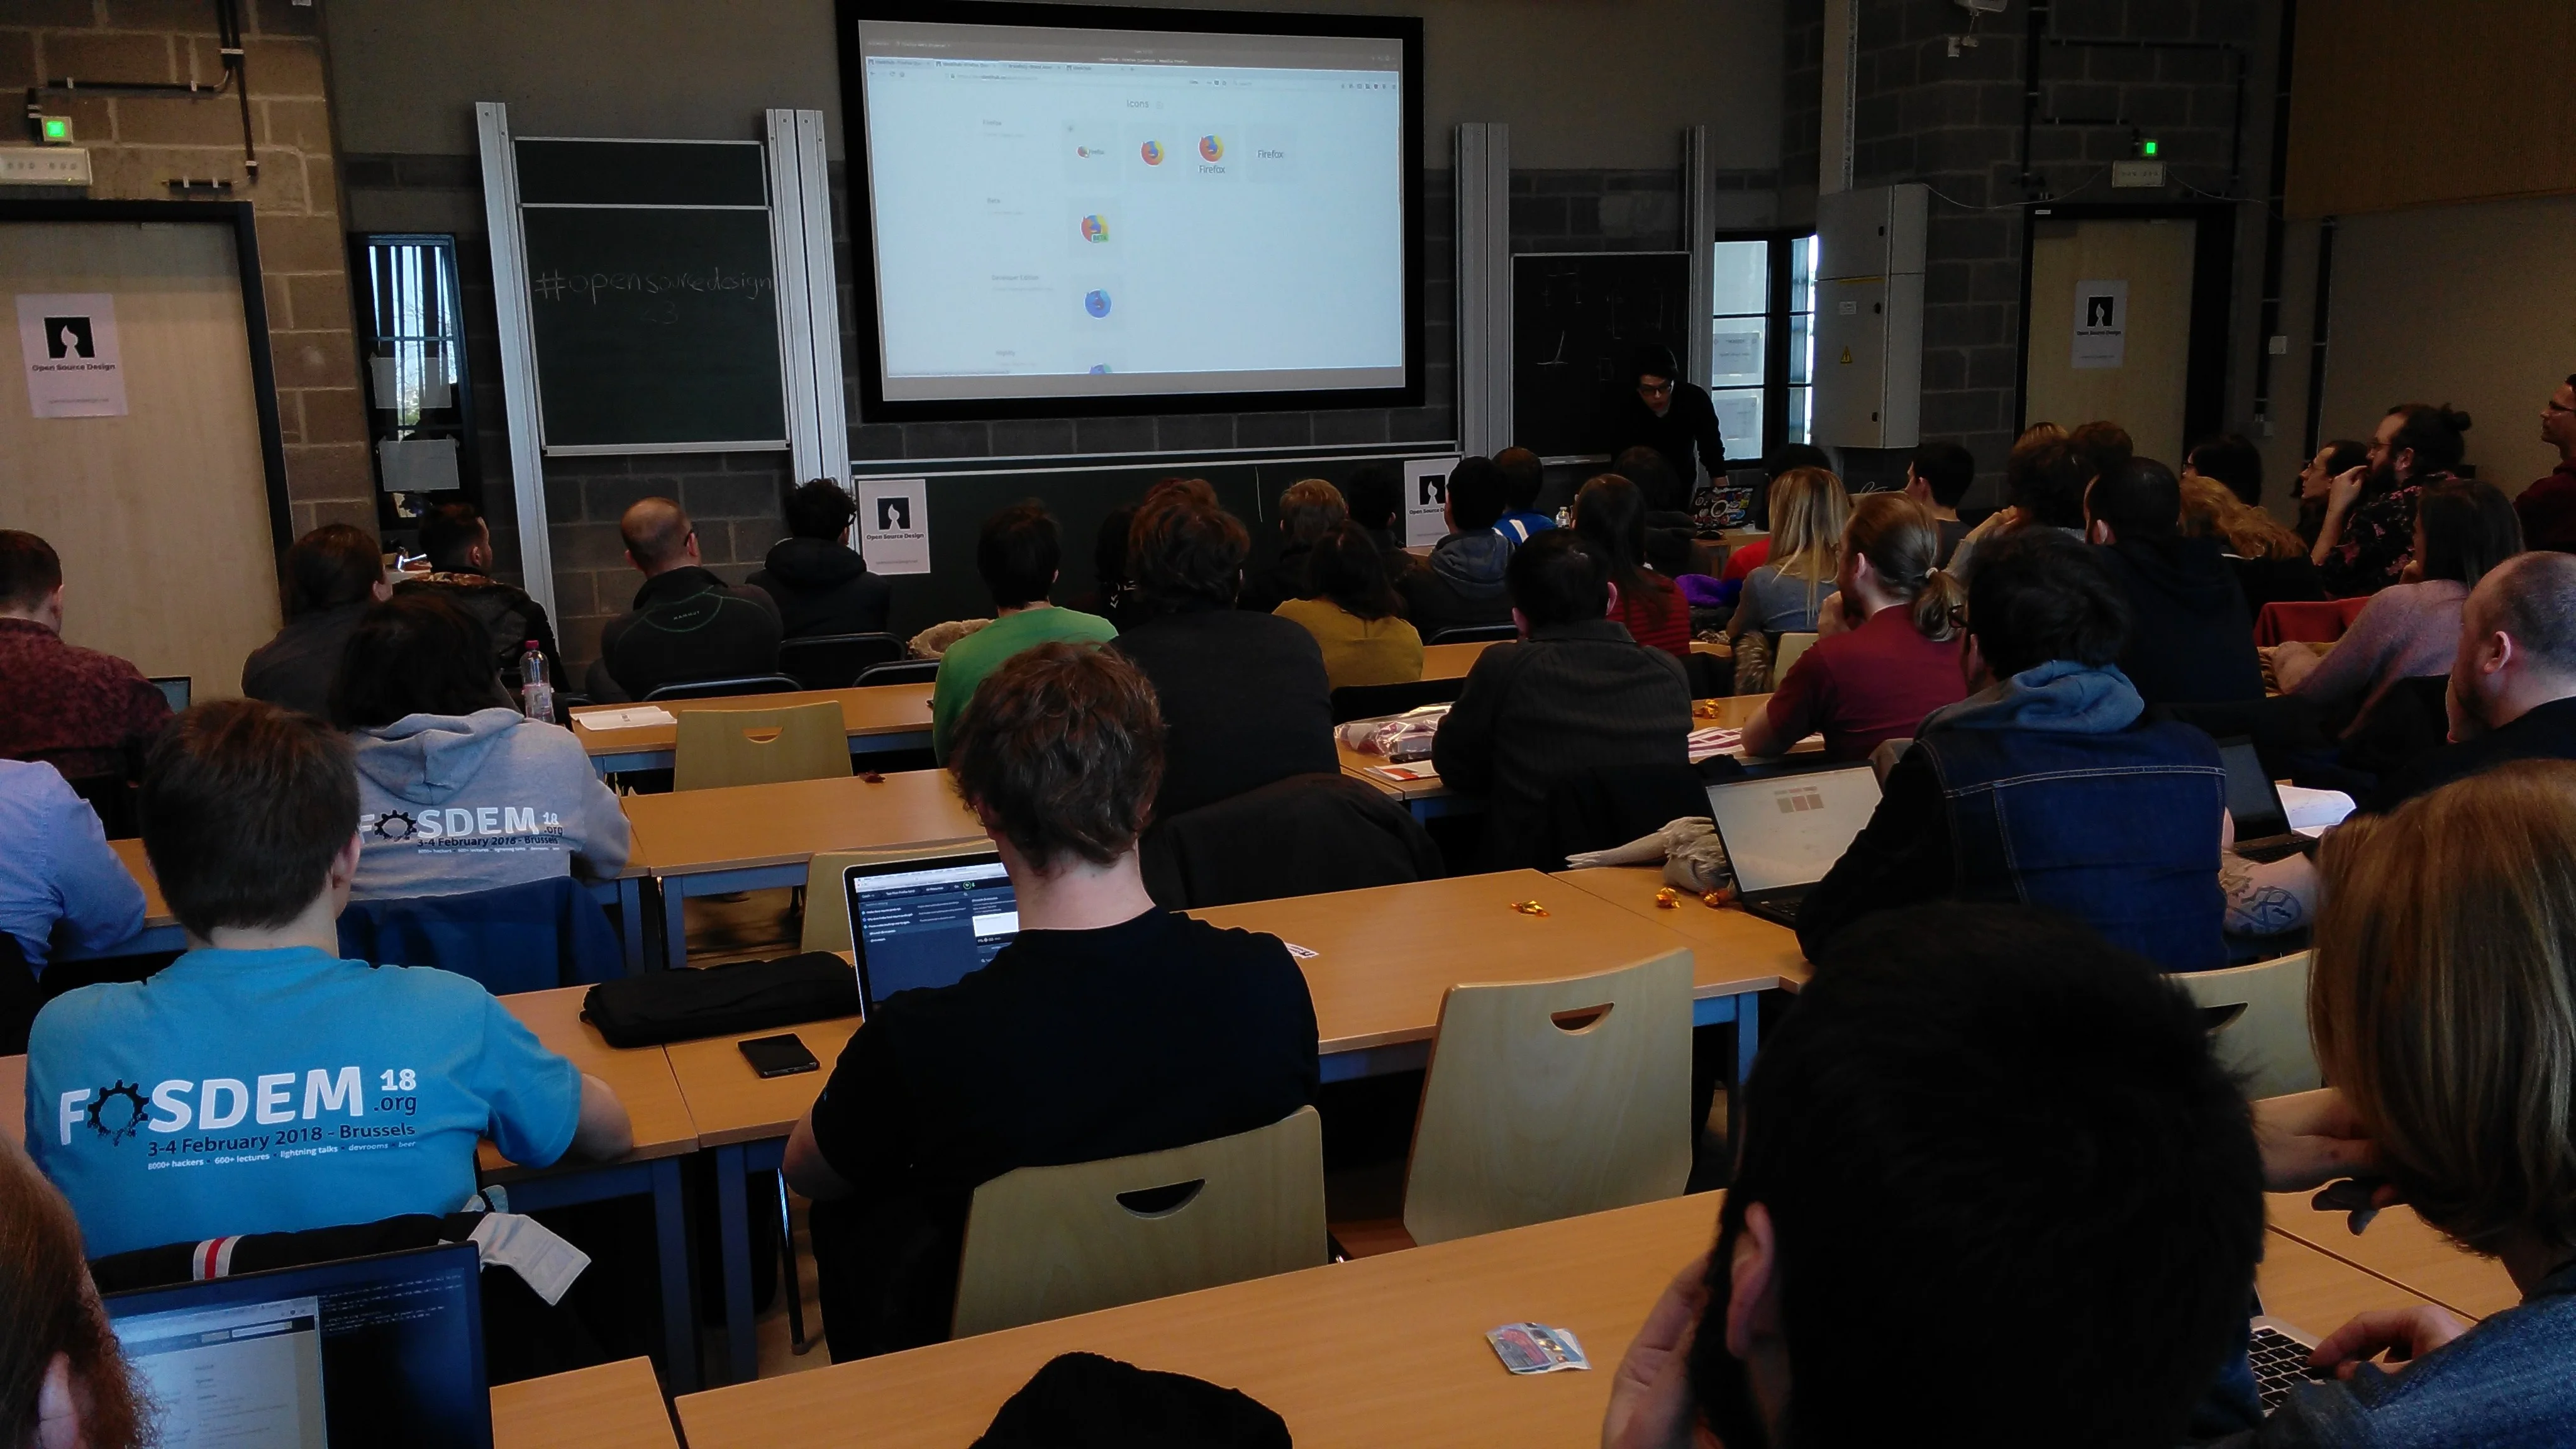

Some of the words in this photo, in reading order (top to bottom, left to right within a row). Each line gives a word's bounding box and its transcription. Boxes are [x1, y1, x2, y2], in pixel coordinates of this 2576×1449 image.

[1258, 150, 1283, 158] Firefox
[1199, 165, 1225, 174] Firefox
[544, 825, 564, 836] .org
[417, 838, 435, 847] 3-4
[438, 837, 489, 847] February
[60, 1066, 364, 1146] FOSDEM
[380, 1069, 416, 1092] 18
[373, 1095, 418, 1116] .org
[148, 1140, 177, 1157] 3-4
[182, 1135, 270, 1153] February
[274, 1126, 323, 1145] 2018
[340, 1121, 416, 1140] Brussels
[172, 1158, 204, 1168] hackers
[236, 1153, 270, 1163] lectures
[280, 1146, 316, 1158] lightning
[318, 1145, 338, 1154] talks
[348, 1142, 389, 1151] devrooms
